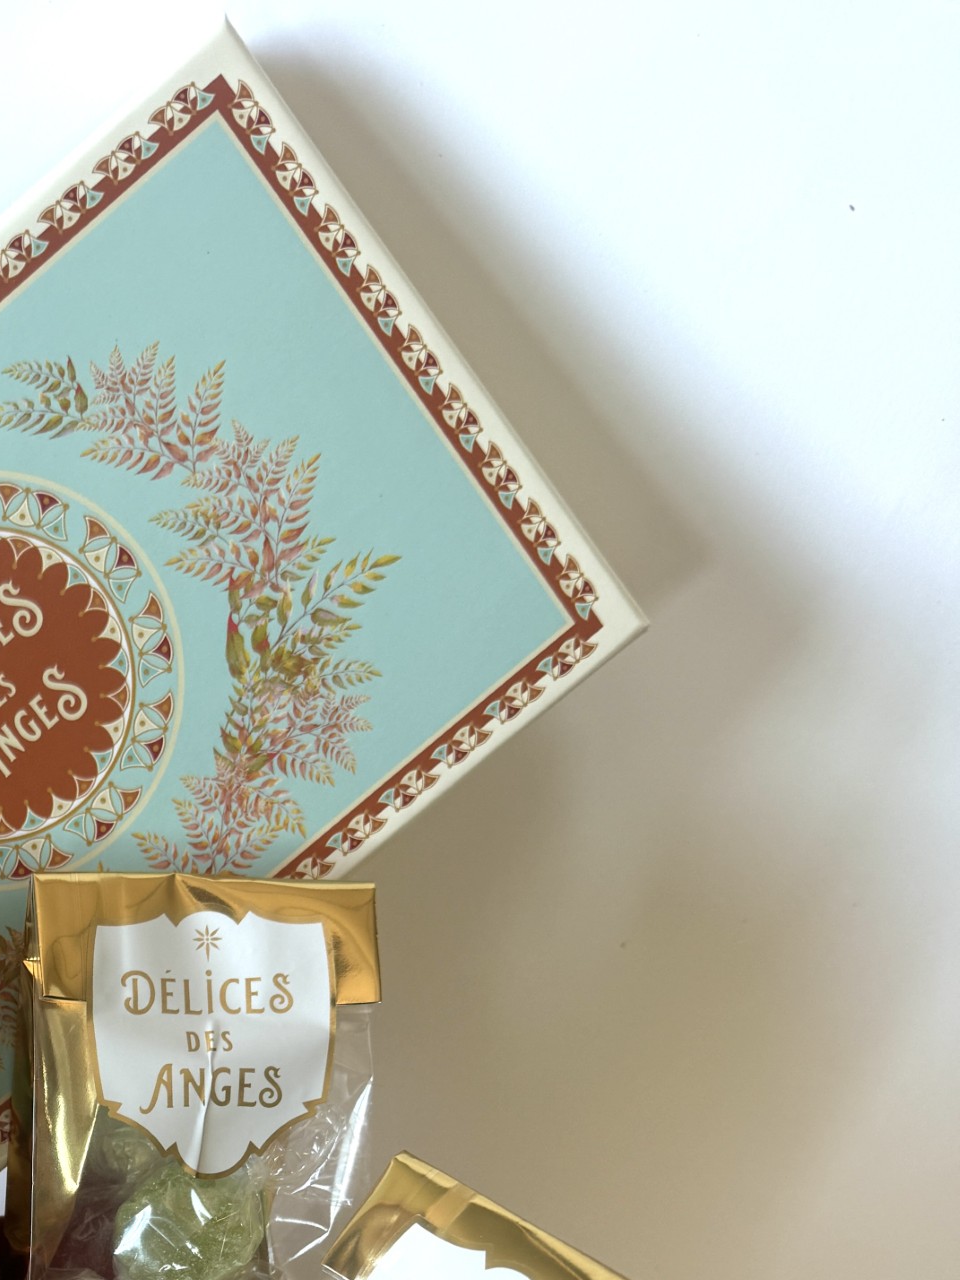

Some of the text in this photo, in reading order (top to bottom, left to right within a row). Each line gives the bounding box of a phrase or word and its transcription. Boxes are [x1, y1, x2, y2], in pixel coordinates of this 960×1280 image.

[120, 969, 294, 1016] DÉLICES
[185, 1030, 234, 1053] DES
[139, 1063, 283, 1115] ANGES
